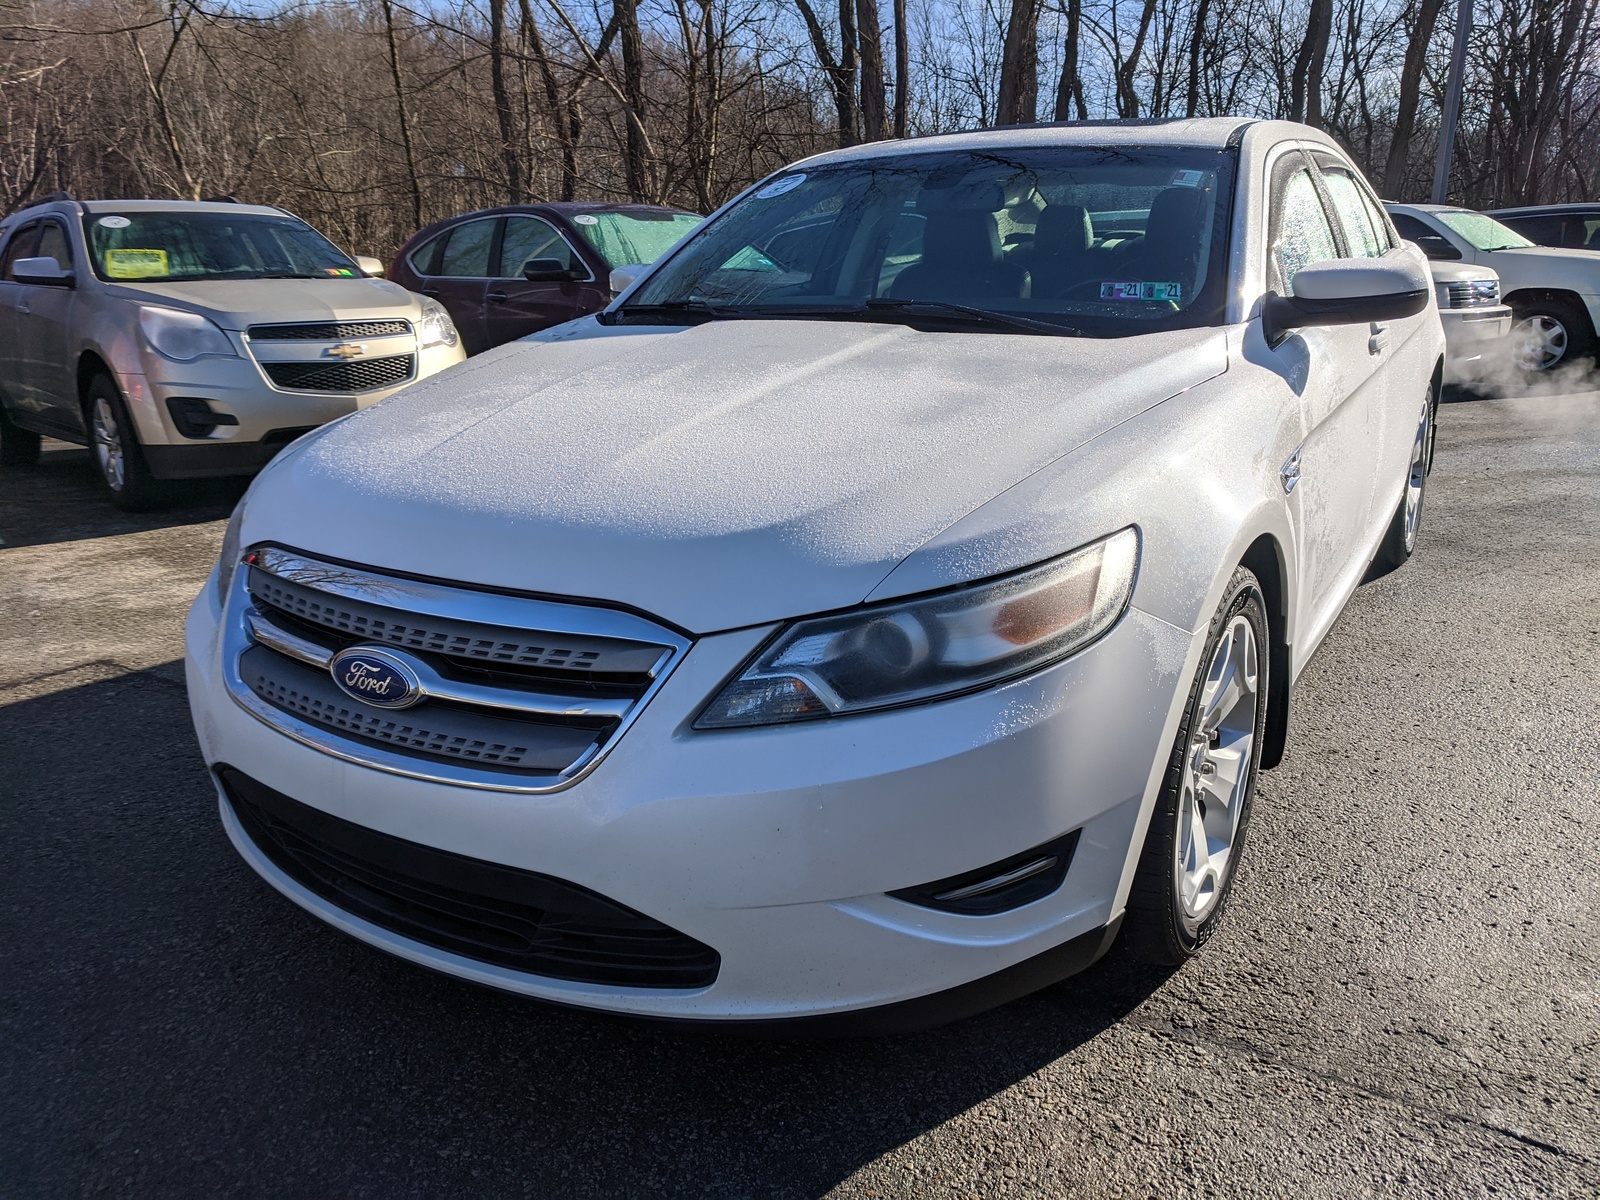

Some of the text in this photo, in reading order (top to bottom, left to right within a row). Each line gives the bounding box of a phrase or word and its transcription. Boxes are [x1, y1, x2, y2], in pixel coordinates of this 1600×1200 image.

[1126, 283, 1138, 296] 21
[1167, 283, 1179, 297] 21
[345, 660, 392, 695] Ford
